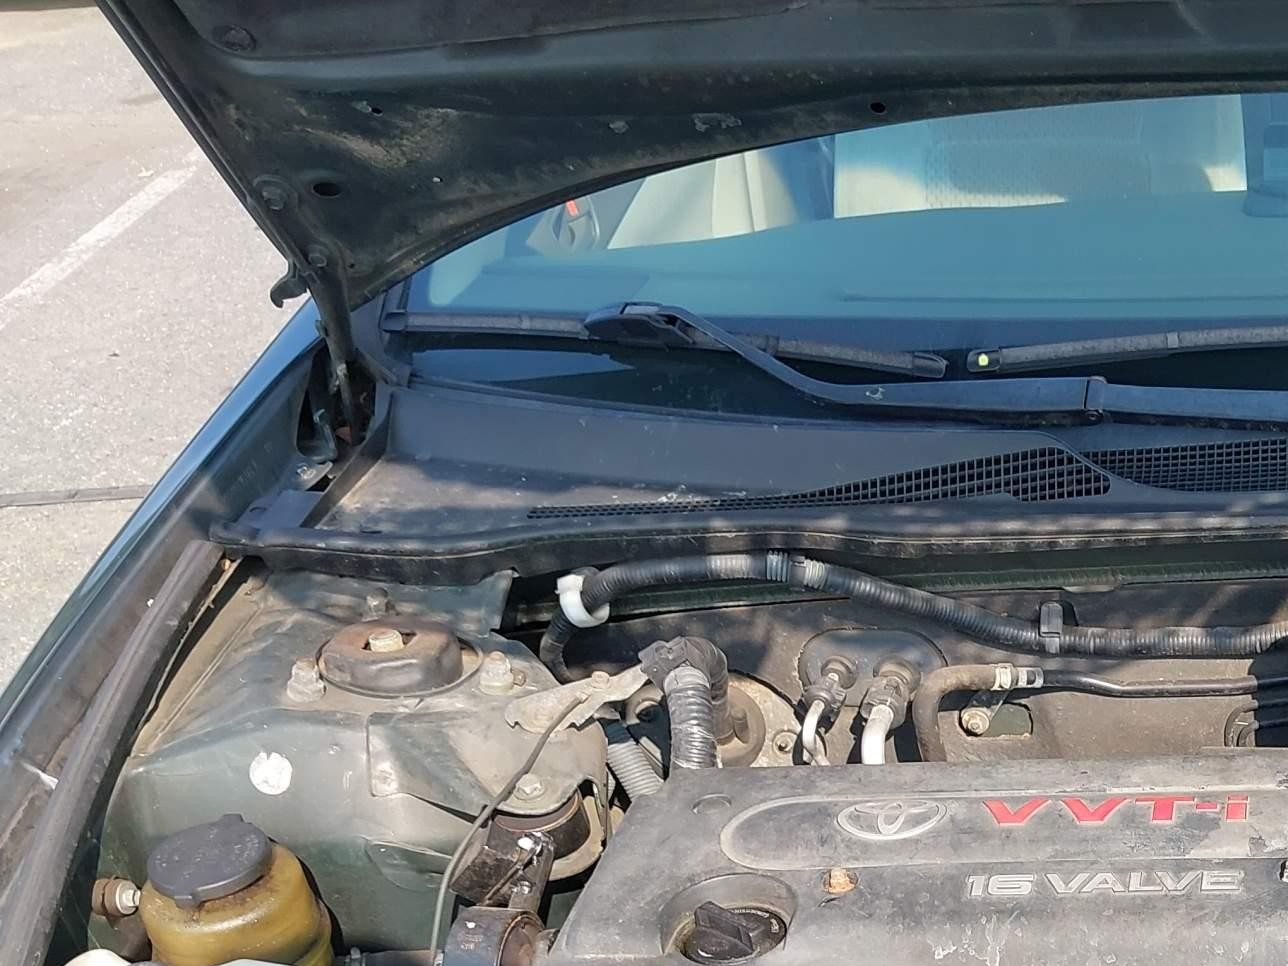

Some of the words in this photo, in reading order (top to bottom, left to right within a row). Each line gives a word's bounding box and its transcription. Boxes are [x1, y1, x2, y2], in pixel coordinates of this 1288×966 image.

[982, 795, 1249, 826] VVT-i
[968, 874, 1036, 897] 16
[1045, 870, 1245, 895] VALVE
